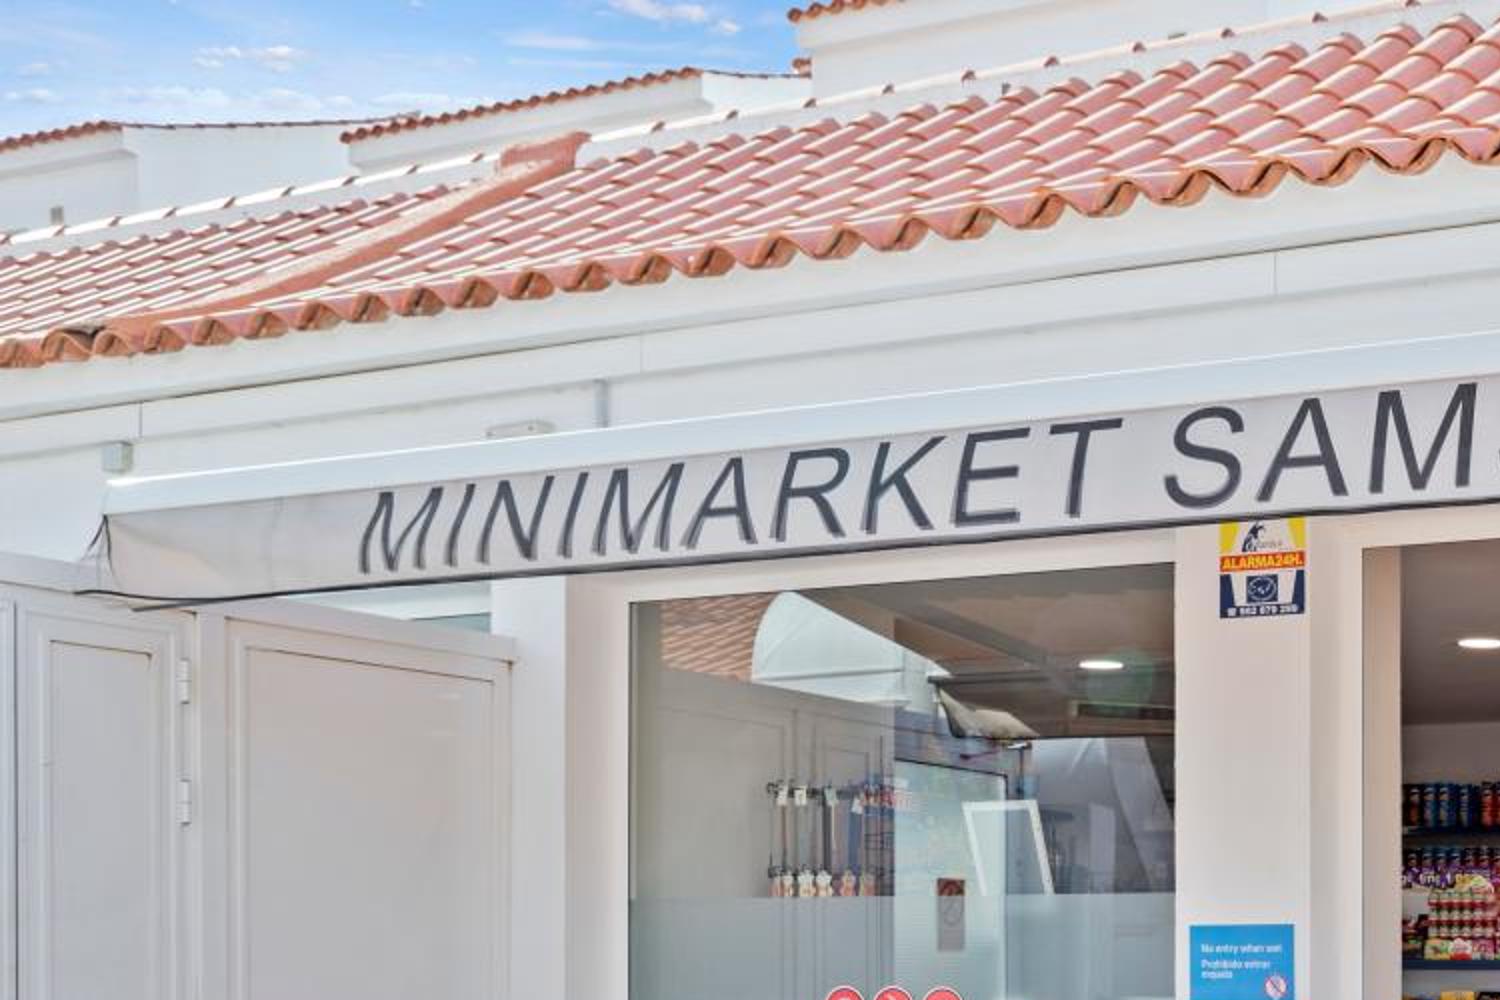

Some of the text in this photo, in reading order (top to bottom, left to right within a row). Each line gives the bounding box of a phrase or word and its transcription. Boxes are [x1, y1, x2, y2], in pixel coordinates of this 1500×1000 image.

[358, 417, 1123, 574] MINIMARKET
[1201, 944, 1215, 954] No
[1215, 944, 1239, 956] entry
